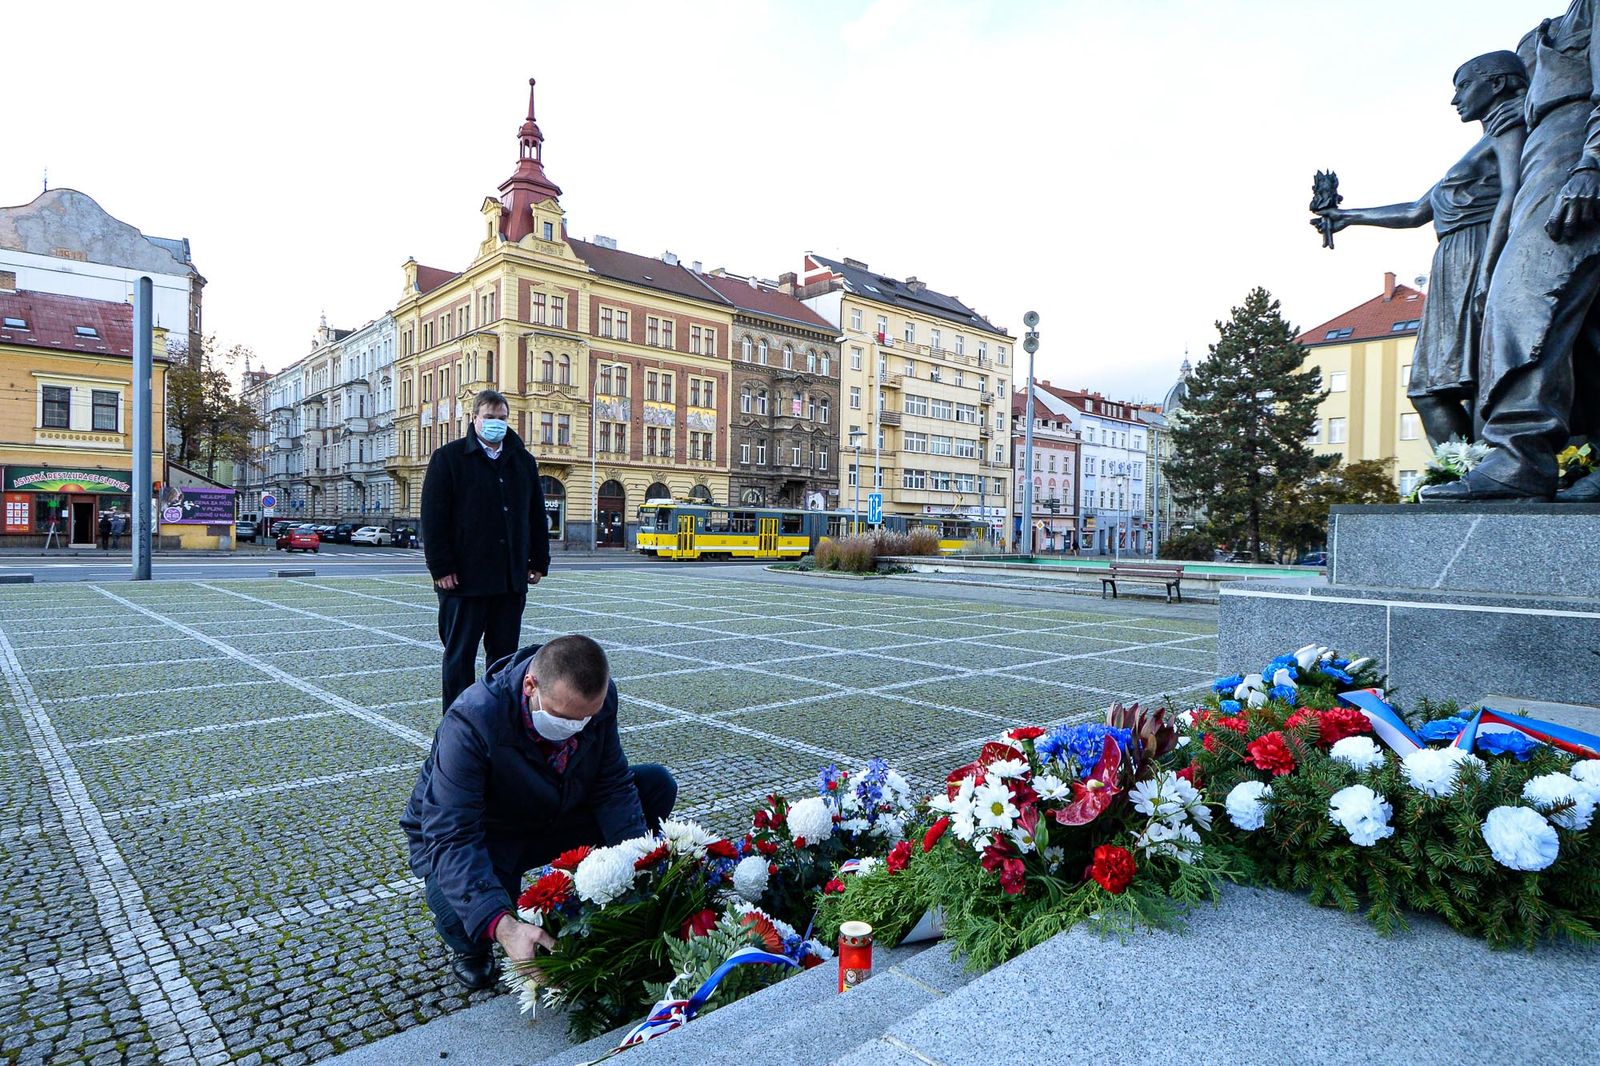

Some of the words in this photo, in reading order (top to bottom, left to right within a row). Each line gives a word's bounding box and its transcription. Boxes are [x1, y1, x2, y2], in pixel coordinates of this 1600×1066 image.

[13, 471, 46, 488] ASIJSKÁ
[47, 471, 99, 482] RESTAURACE
[99, 475, 131, 492] SLUNCE
